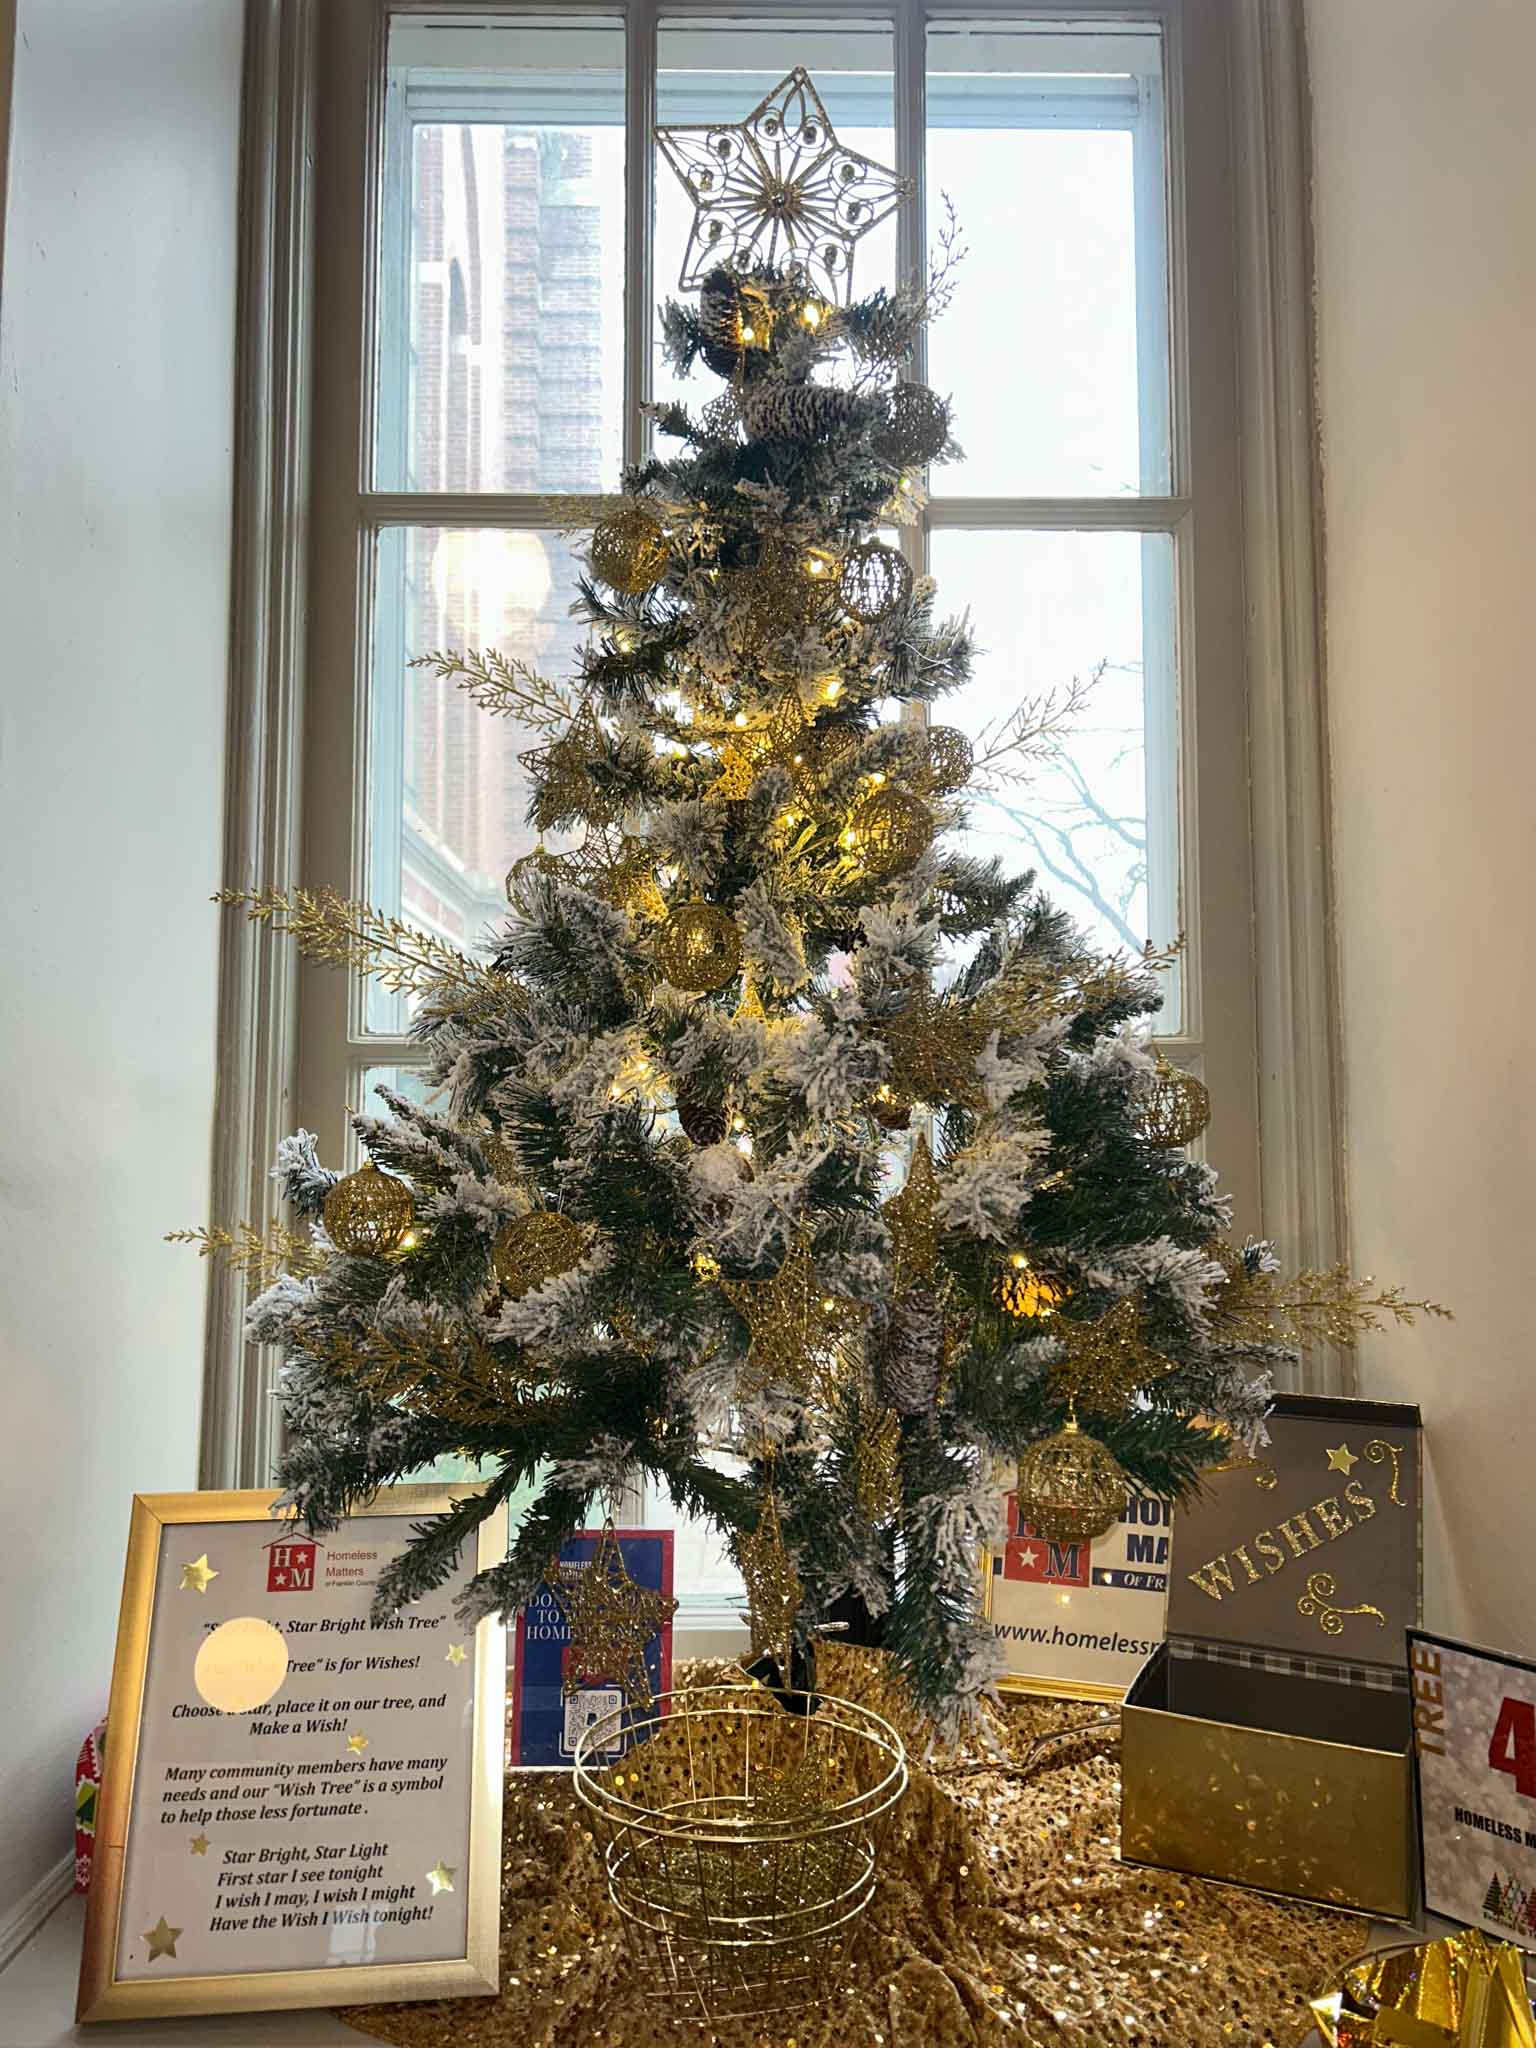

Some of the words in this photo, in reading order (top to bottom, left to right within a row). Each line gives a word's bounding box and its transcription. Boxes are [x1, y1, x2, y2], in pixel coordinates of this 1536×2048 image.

[1187, 1480, 1377, 1600] WISHES
[327, 1550, 378, 1561] Homeless
[326, 1566, 364, 1577] Matters
[286, 1619, 317, 1634] Star
[320, 1617, 366, 1635] Bright
[369, 1617, 404, 1631] Wish
[537, 1610, 560, 1624] TO
[325, 1658, 338, 1672] is
[339, 1657, 361, 1675] for
[365, 1655, 421, 1671] Wishes!
[276, 1699, 315, 1717] place
[318, 1697, 329, 1713] it
[332, 1700, 351, 1713] on
[354, 1697, 380, 1711] our
[383, 1695, 415, 1711] tree,
[419, 1693, 447, 1708] and
[1411, 1647, 1446, 1758] TREE
[250, 1720, 289, 1737] Make
[292, 1722, 302, 1734] a
[306, 1717, 348, 1733] Wish!
[165, 1766, 206, 1784] Many
[209, 1761, 295, 1780] community
[297, 1758, 366, 1776] members
[369, 1757, 404, 1773] have
[407, 1756, 448, 1773] many
[162, 1788, 207, 1803] needs
[210, 1785, 240, 1801] and
[242, 1785, 270, 1800] our
[363, 1778, 375, 1794] is
[378, 1780, 388, 1793] a
[391, 1775, 445, 1795] symbol
[160, 1810, 176, 1825] to
[179, 1807, 212, 1826] help
[215, 1805, 256, 1823] those
[259, 1804, 288, 1820] less
[1454, 1806, 1523, 1845] HOMELESS
[222, 1850, 256, 1865] Star
[258, 1847, 311, 1864] Bright,
[314, 1845, 347, 1860] Star
[349, 1842, 389, 1860] Light
[217, 1871, 253, 1888] First
[256, 1871, 288, 1885] star
[291, 1868, 298, 1883] I
[300, 1869, 325, 1882] see
[328, 1864, 384, 1884] tonight
[215, 1894, 223, 1909] I
[226, 1893, 260, 1908] wish
[264, 1892, 272, 1906] I
[274, 1893, 310, 1909] may,
[313, 1889, 320, 1904] I
[323, 1887, 358, 1902] wish
[361, 1886, 369, 1901] I
[371, 1885, 416, 1903] might
[209, 1916, 249, 1932] Have
[252, 1914, 277, 1929] the
[281, 1912, 319, 1927] Wish
[321, 1911, 329, 1925] I
[332, 1909, 369, 1925] Wish
[373, 1905, 434, 1925] tonight!
